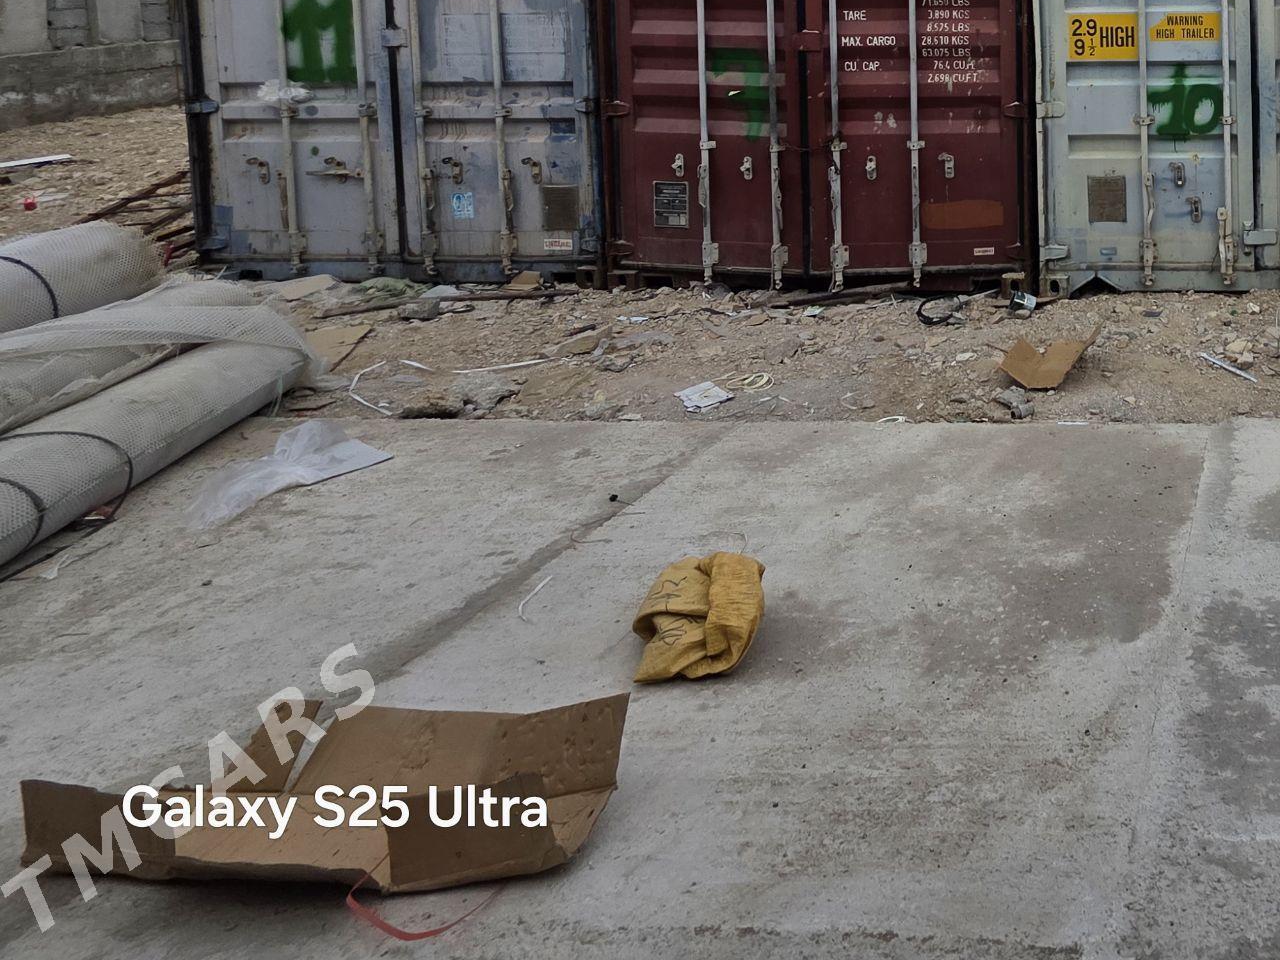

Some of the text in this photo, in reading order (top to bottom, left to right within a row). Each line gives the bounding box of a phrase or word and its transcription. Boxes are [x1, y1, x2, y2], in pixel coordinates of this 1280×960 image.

[843, 10, 867, 20] TARE
[953, 10, 970, 19] KGS
[1167, 15, 1203, 26] WARNING
[952, 23, 970, 32] LBS
[1071, 19, 1097, 37] 2.9
[1100, 26, 1135, 48] HIGH
[1156, 28, 1215, 39] HIGH TRAILER
[841, 37, 863, 46] MAX.
[867, 36, 896, 46] CARGO
[951, 36, 969, 45] KGS
[953, 48, 971, 57] LBS
